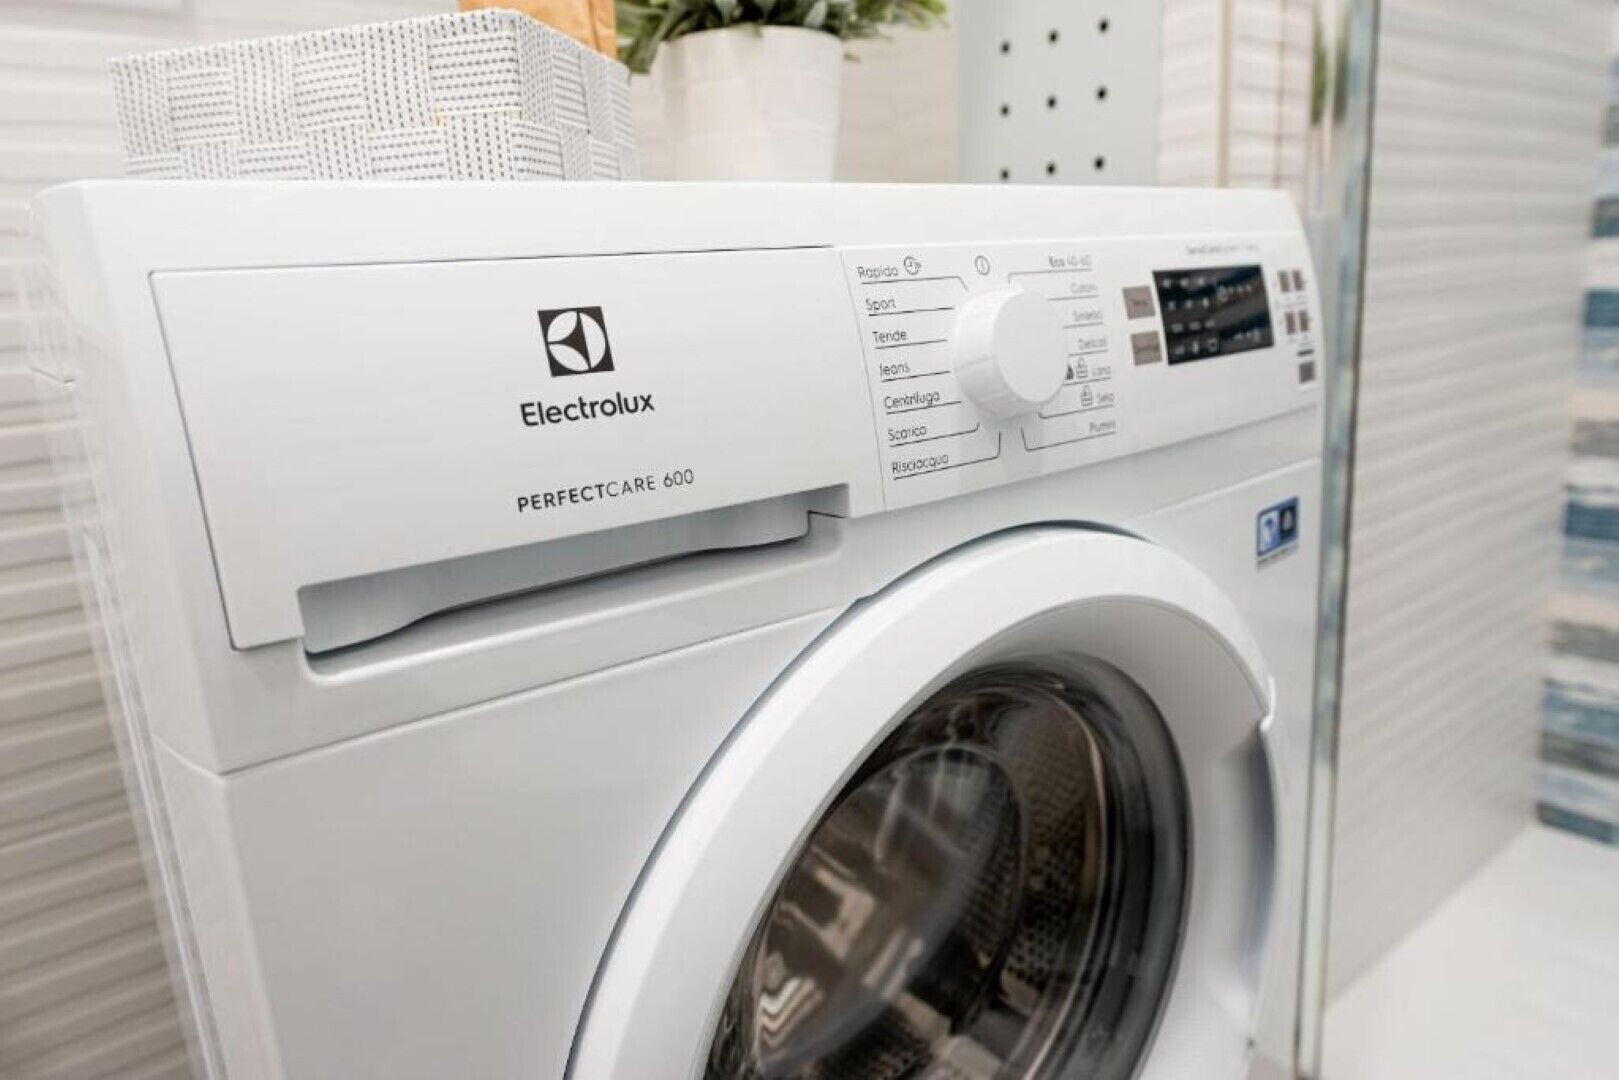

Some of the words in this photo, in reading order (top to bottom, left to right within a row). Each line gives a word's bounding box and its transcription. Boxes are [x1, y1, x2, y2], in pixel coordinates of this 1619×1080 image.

[857, 265, 899, 279] Rapido
[865, 298, 897, 311] Sport
[872, 330, 908, 343] Tende
[879, 362, 910, 377] Jeans
[884, 391, 940, 409] Centrifuga
[520, 391, 655, 427] Electrolux
[887, 425, 927, 441] Scarico
[892, 454, 949, 474] Risciacquo
[517, 475, 656, 512] PERFECTCARE
[663, 468, 694, 488] 600
